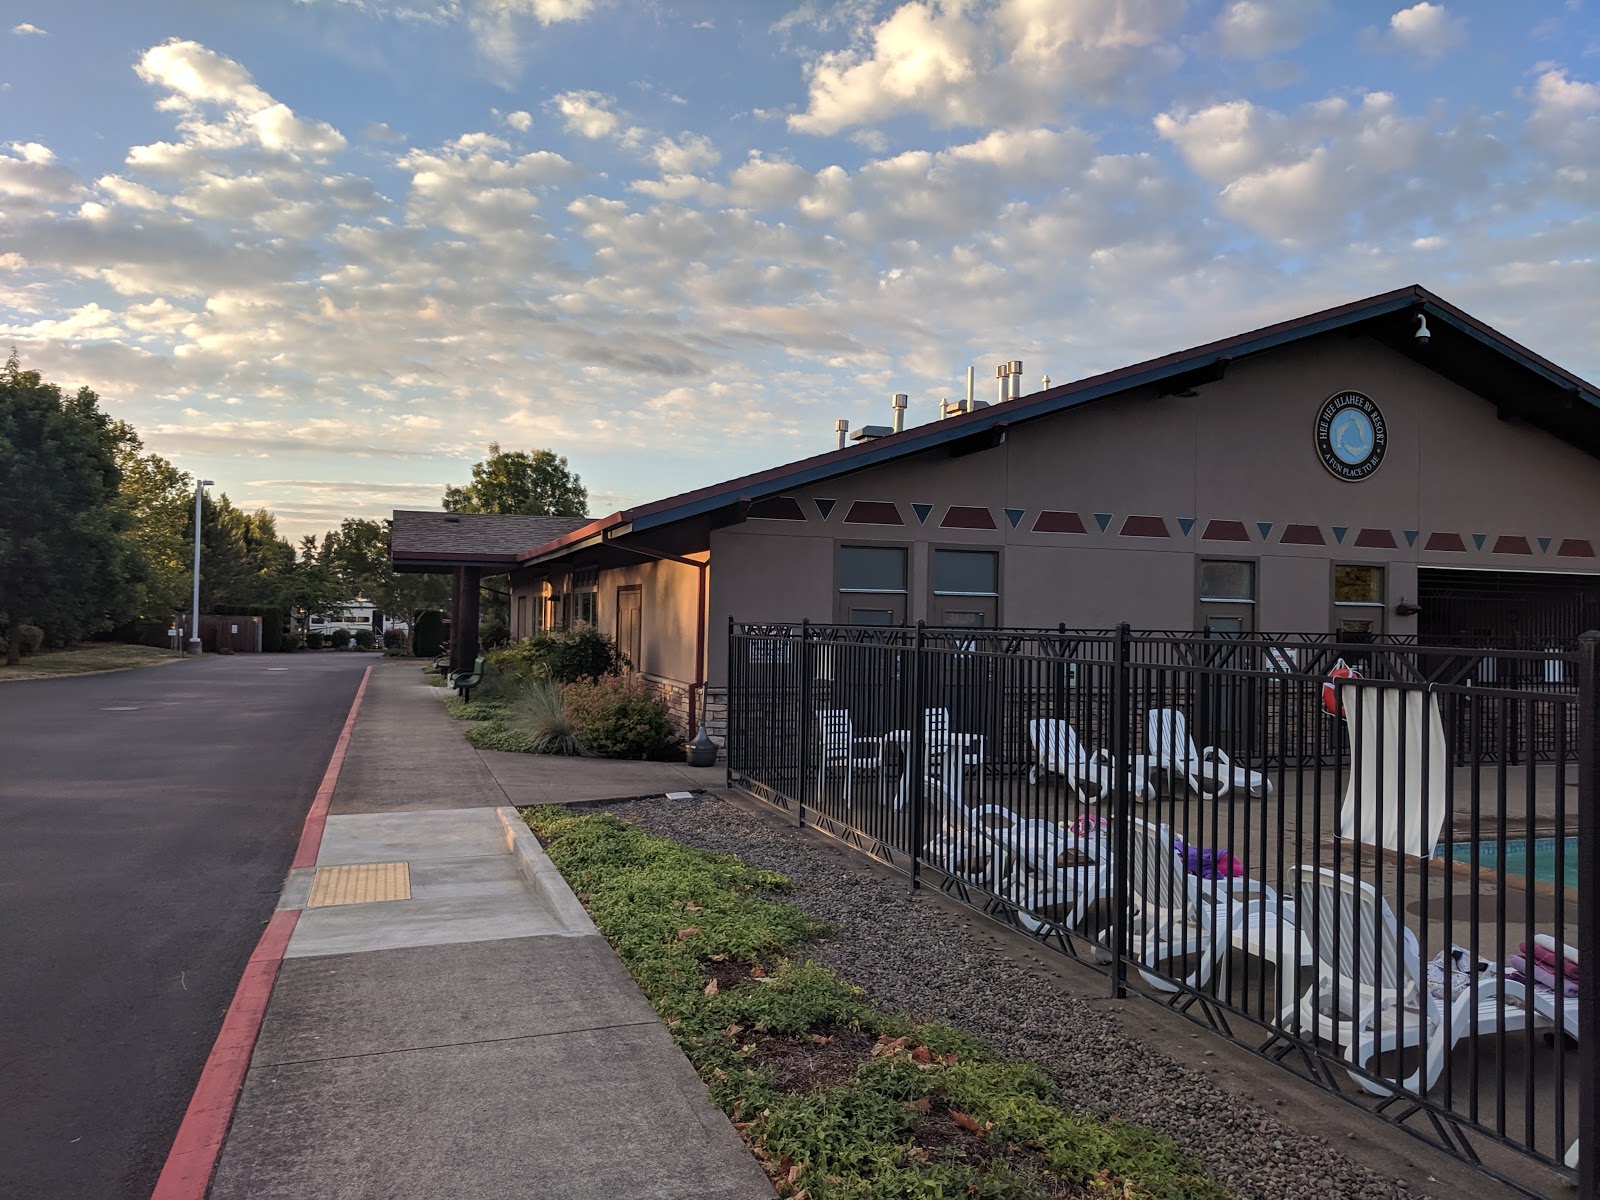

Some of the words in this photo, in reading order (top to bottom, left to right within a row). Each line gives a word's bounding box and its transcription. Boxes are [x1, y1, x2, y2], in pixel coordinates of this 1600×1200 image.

[1334, 394, 1364, 408] ILLAHEE
[1363, 401, 1374, 412] RV
[1322, 403, 1337, 421] HEE
[1319, 421, 1328, 440] HEE
[1370, 411, 1384, 445] RESORT
[1329, 458, 1343, 473] FUN
[1343, 467, 1362, 477] PLACE
[1362, 463, 1372, 474] TO
[1371, 455, 1380, 466] BE
